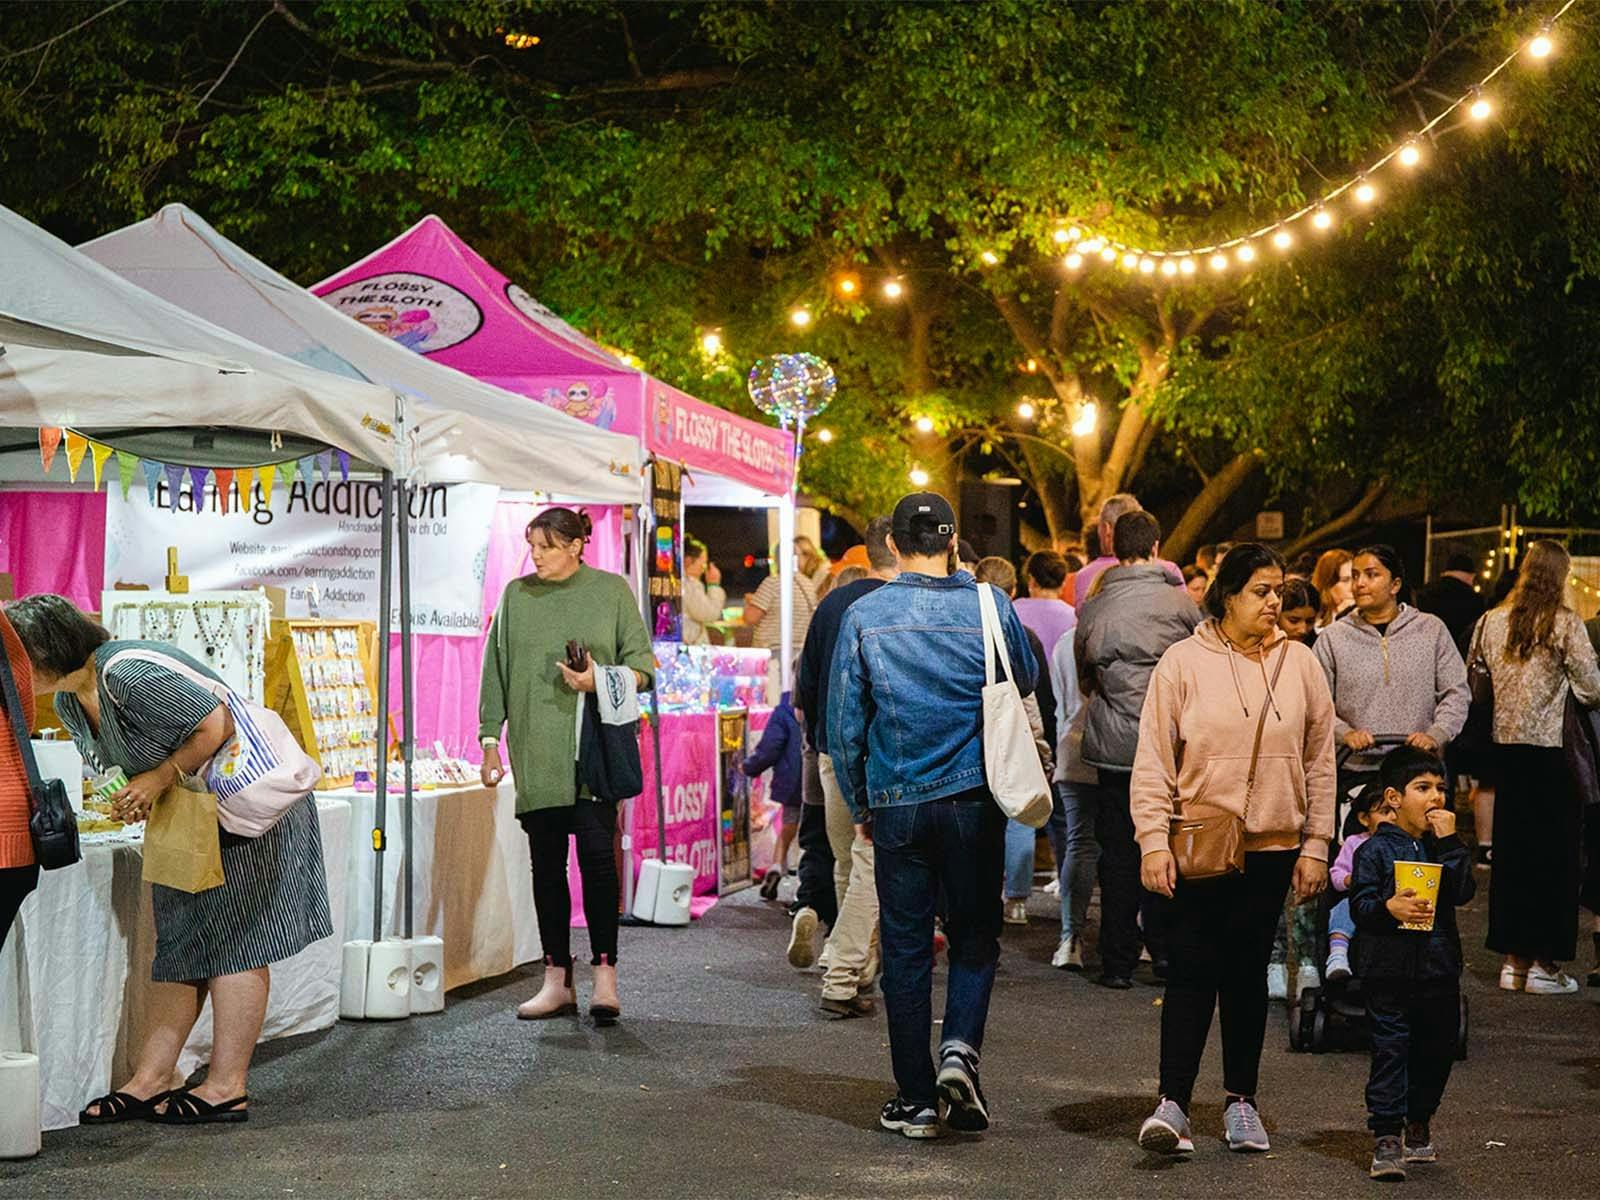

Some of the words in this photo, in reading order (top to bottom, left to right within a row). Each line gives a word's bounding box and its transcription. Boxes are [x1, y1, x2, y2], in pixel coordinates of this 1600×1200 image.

[361, 282, 433, 292] FLOSSY
[340, 294, 377, 305] THE
[378, 295, 443, 307] SLOTH
[676, 406, 718, 451] FLOSSY
[719, 421, 741, 460] THE
[323, 587, 366, 601] Addiction
[661, 782, 709, 825] LOSSY
